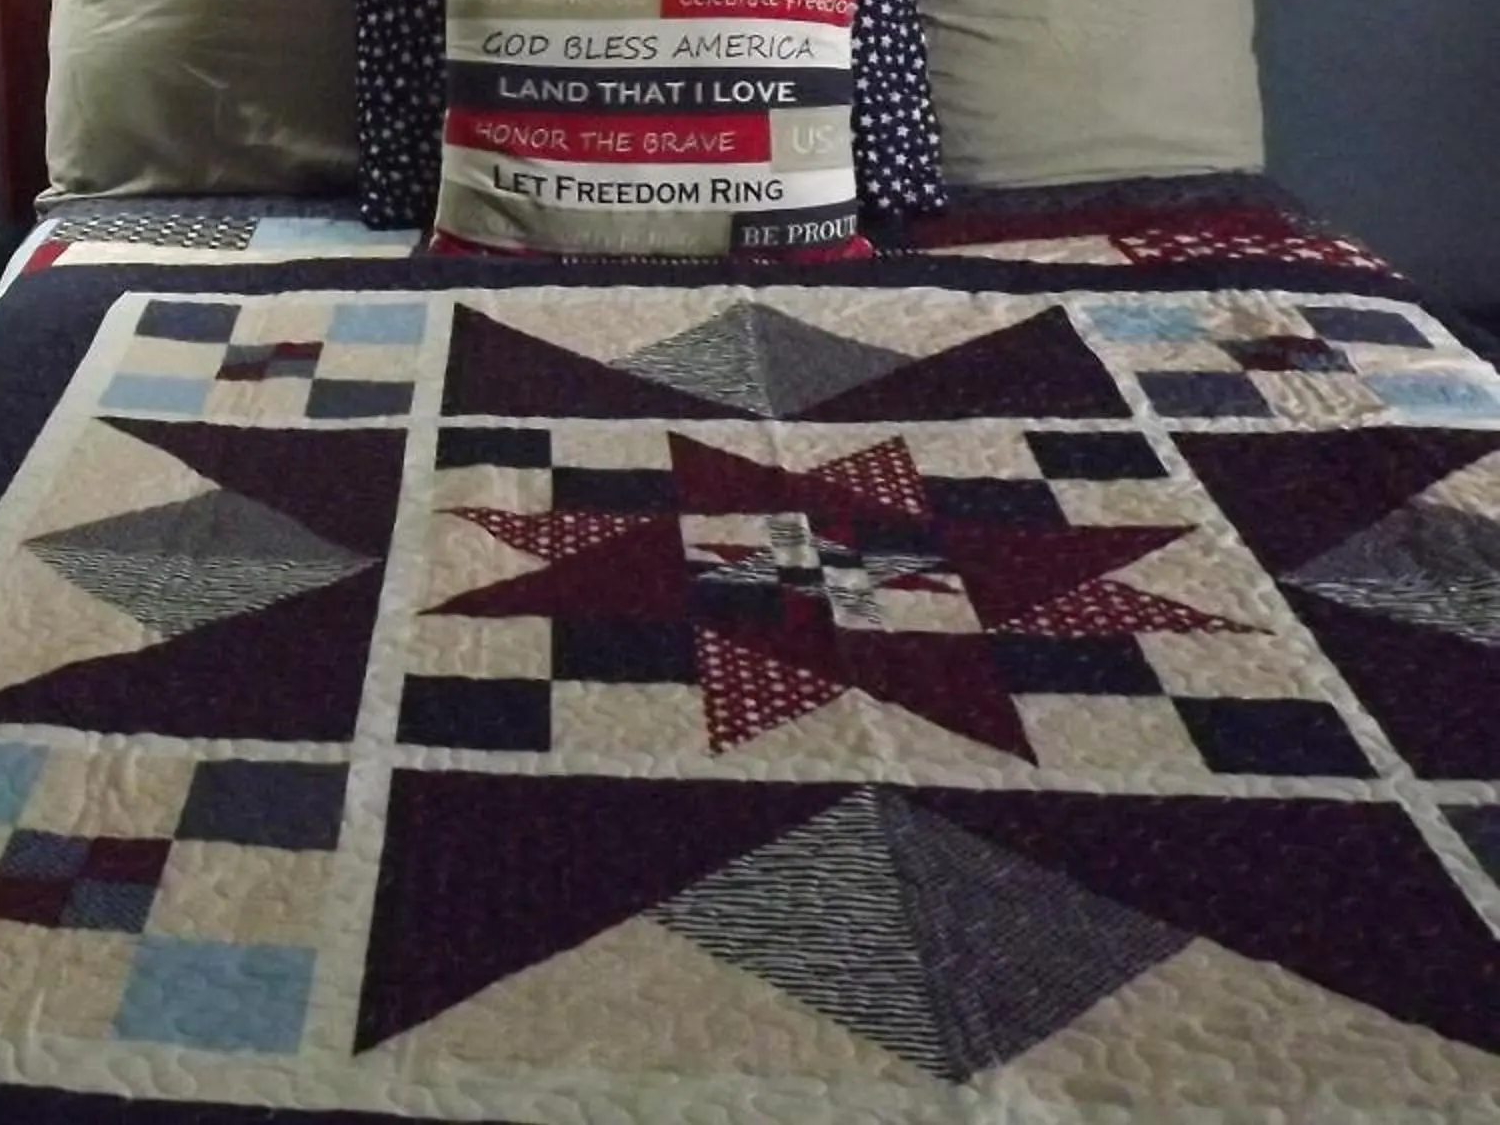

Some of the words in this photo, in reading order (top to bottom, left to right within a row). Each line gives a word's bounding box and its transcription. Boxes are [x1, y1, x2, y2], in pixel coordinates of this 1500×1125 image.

[483, 31, 549, 56] GOD
[563, 35, 658, 59] BLESS
[672, 35, 814, 59] AMERICA
[500, 81, 588, 101] LAND
[597, 82, 681, 103] THAT
[694, 83, 701, 103] I
[713, 82, 797, 103] LOVE
[474, 125, 568, 151] HONOR
[580, 132, 632, 152] THE
[643, 131, 735, 152] BRAVE
[493, 165, 546, 195] LET
[555, 176, 700, 203] FREEDOM
[710, 177, 784, 203] RING
[742, 226, 779, 246] BE
